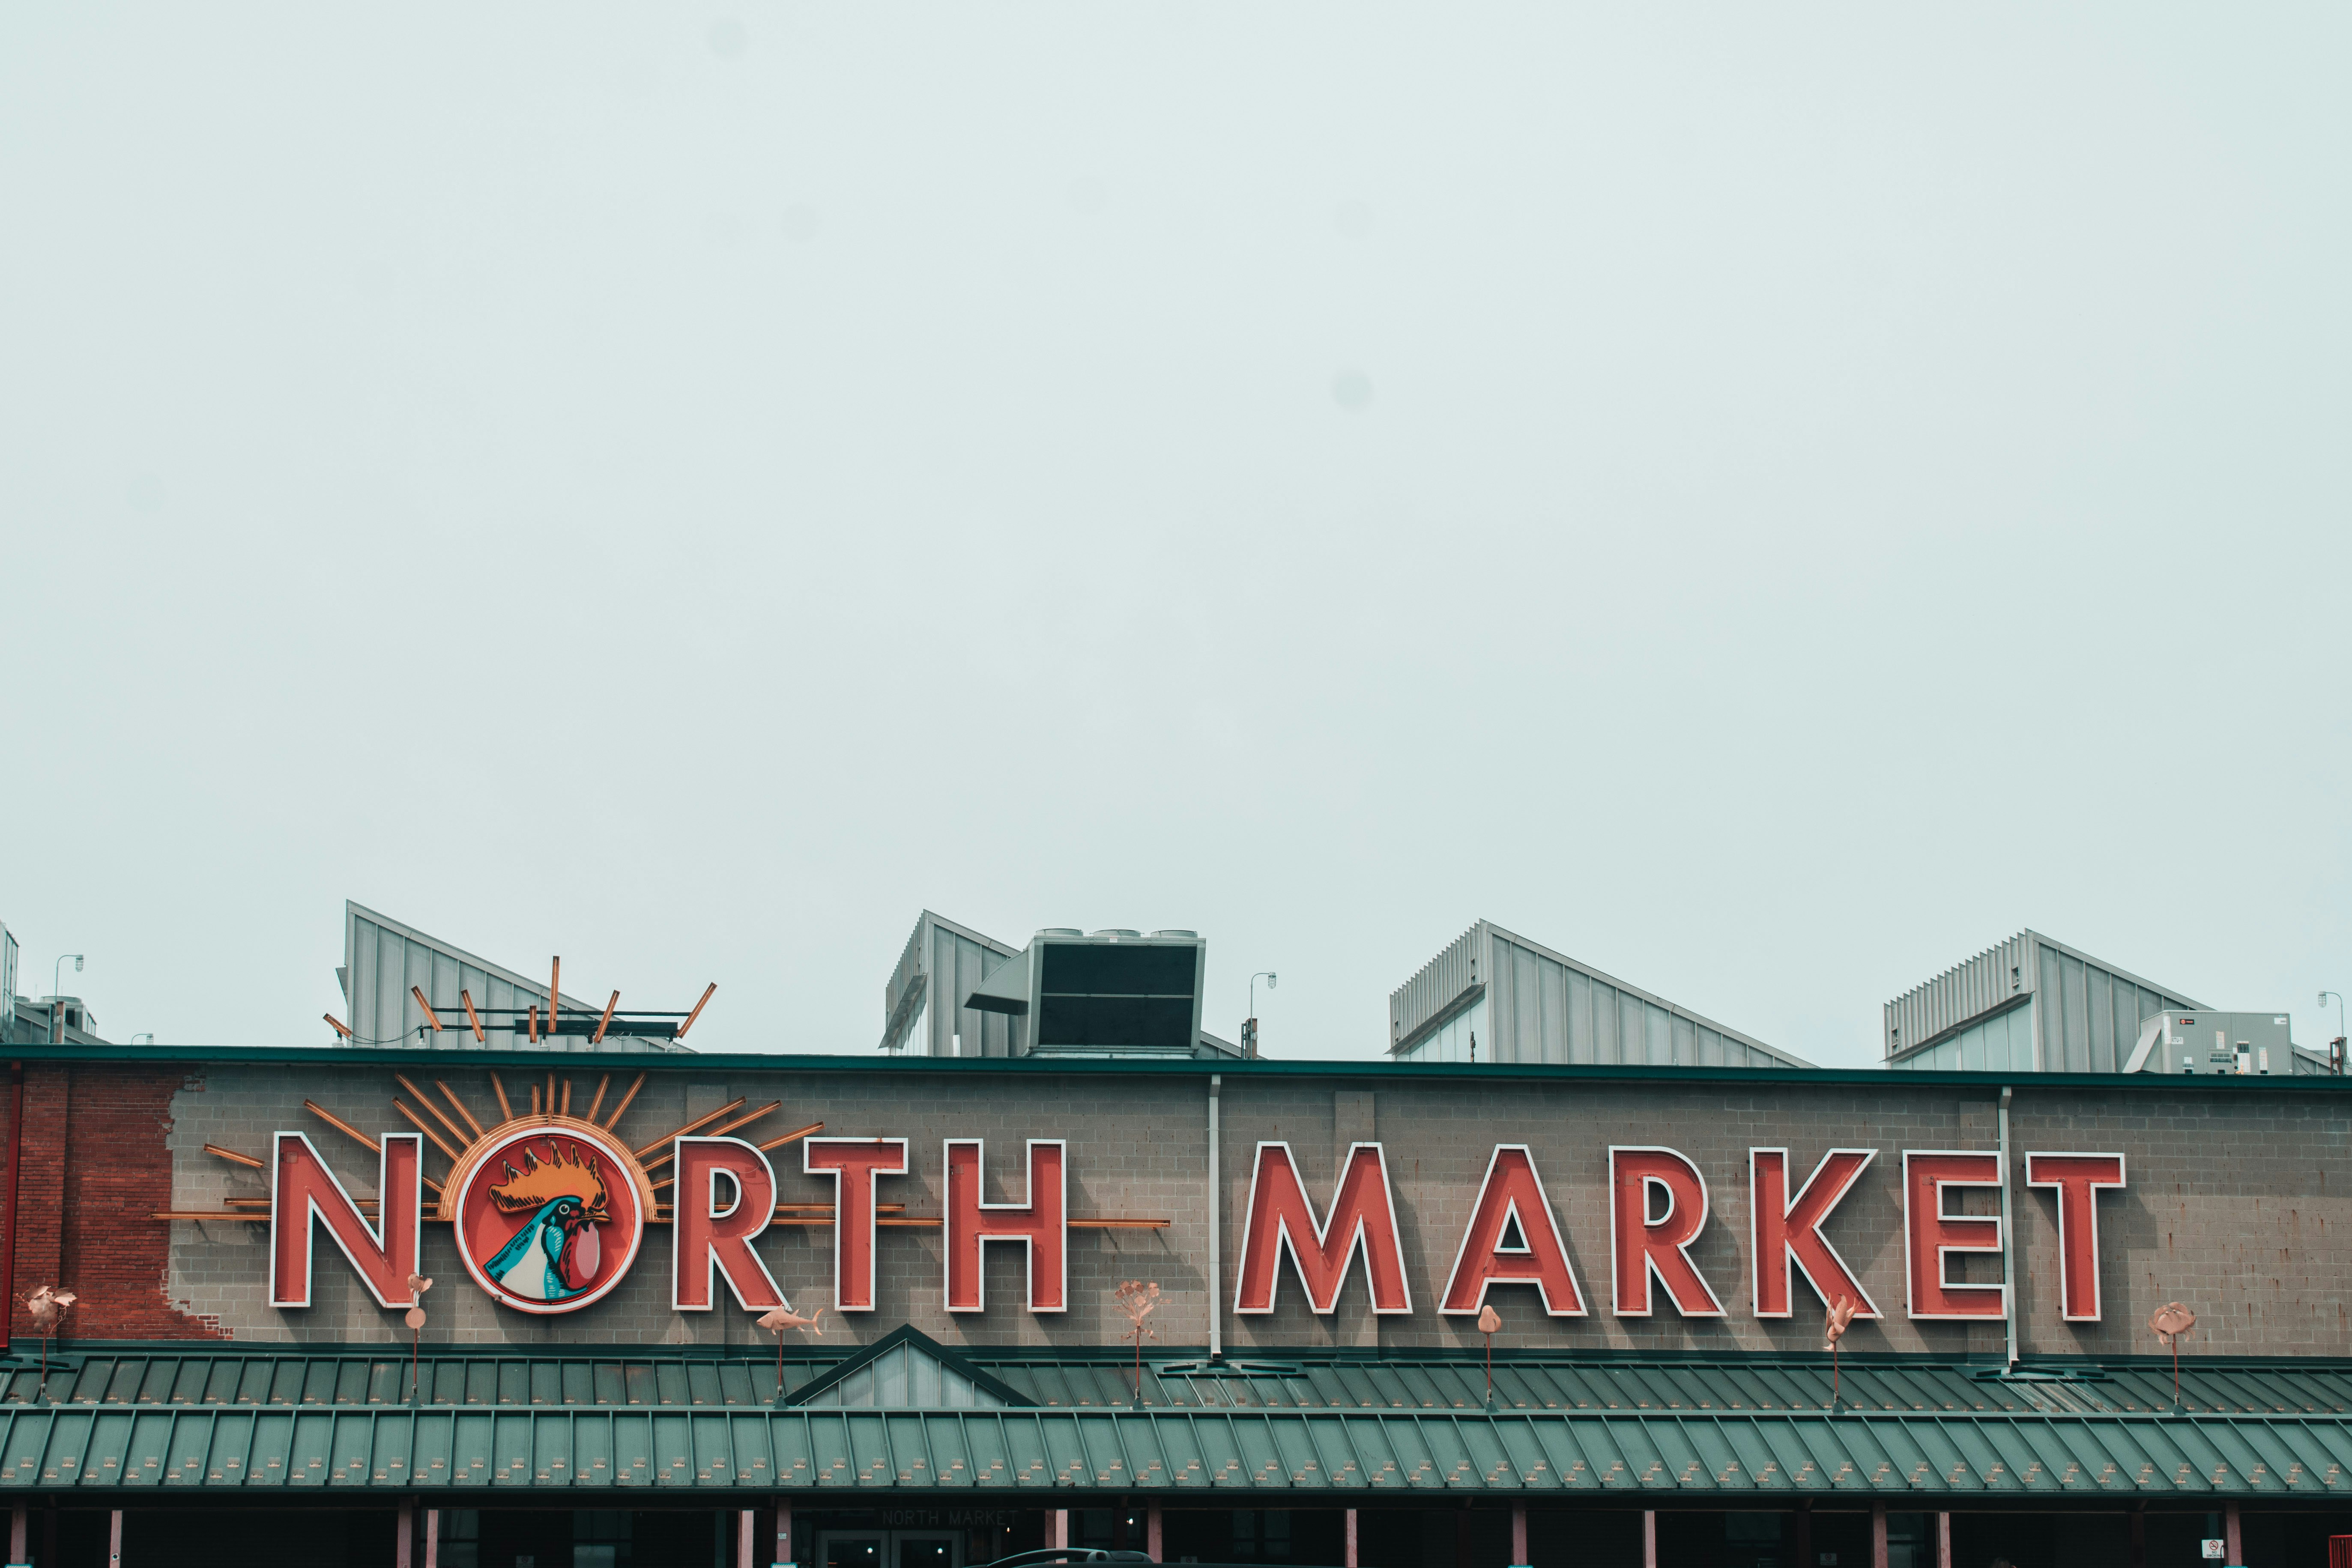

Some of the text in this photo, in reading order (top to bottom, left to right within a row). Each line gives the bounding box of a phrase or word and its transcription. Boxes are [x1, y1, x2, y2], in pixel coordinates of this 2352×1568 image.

[269, 1127, 2126, 1321] NORTH MARKET
[883, 1510, 1018, 1525] NORTH MARKET
